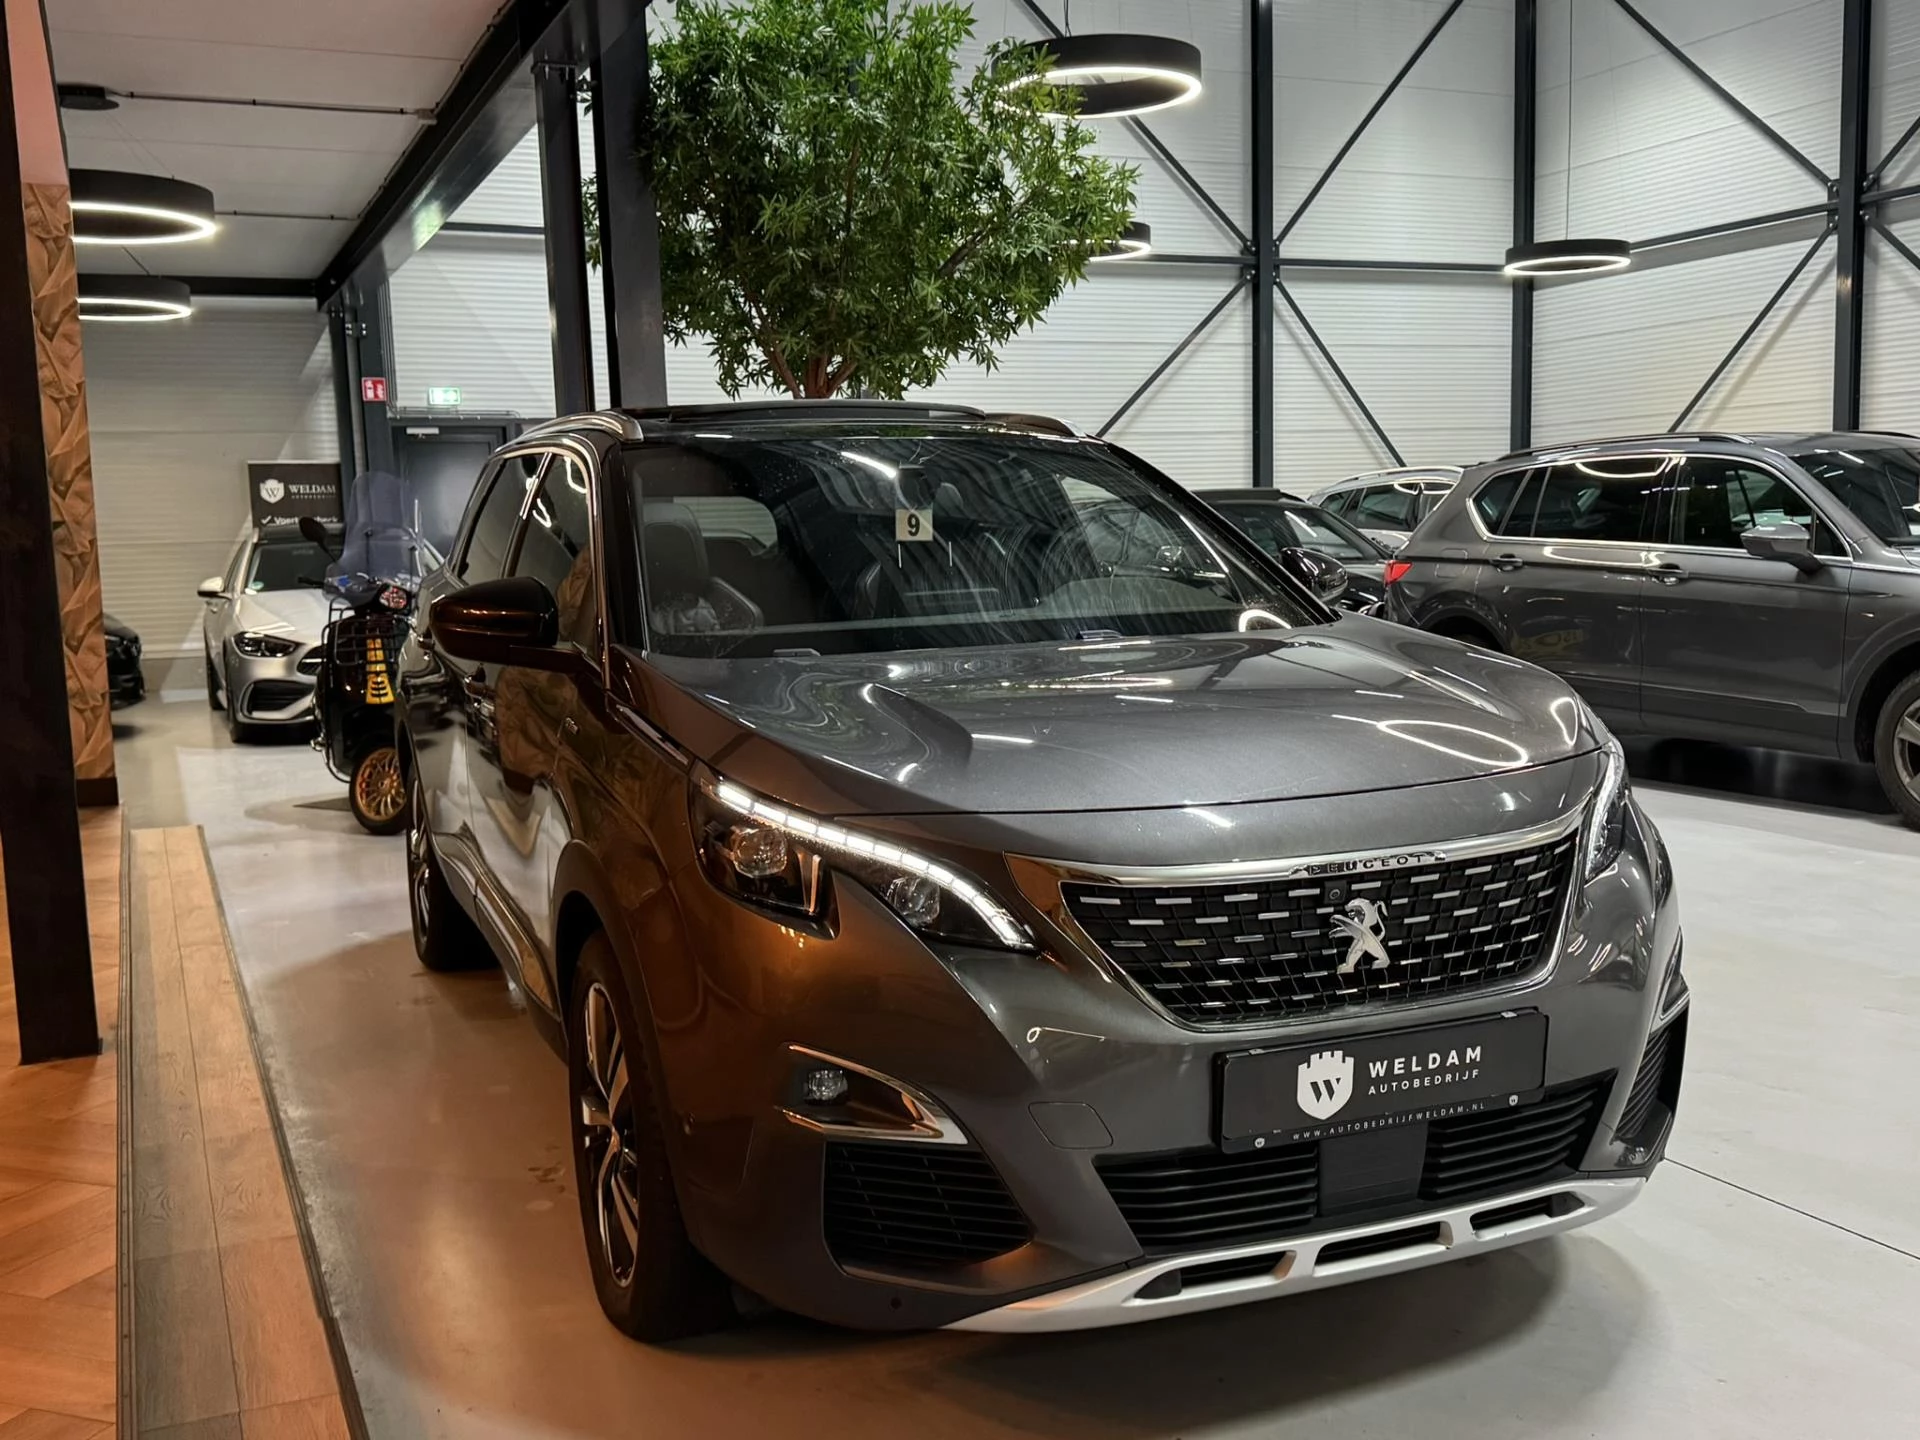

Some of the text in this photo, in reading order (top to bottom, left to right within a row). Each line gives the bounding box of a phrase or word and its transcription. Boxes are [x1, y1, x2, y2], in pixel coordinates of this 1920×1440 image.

[288, 484, 337, 494] WELDAM
[907, 513, 921, 537] 9
[1309, 853, 1423, 876] PEUGEOT
[1368, 1045, 1482, 1079] WELDAM
[1368, 1069, 1480, 1095] AUTOBEDRIJF
[1293, 1102, 1486, 1140] WWW.AUTOBEDRIJFWELDAM.NL
